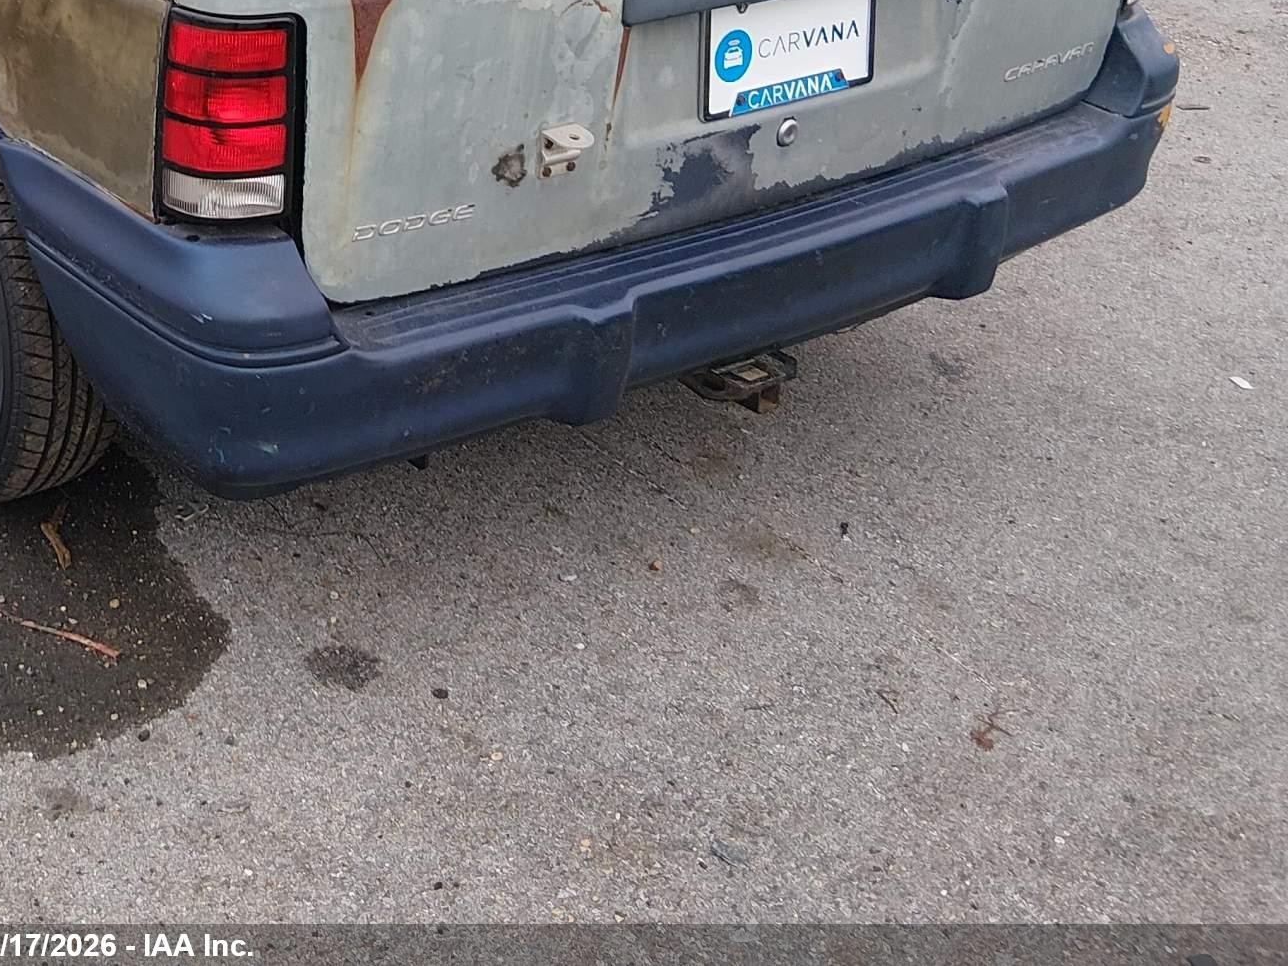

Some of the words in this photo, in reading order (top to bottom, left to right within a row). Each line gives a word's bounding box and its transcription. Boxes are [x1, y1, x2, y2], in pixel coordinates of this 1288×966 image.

[758, 19, 860, 59] CARVANA
[748, 74, 833, 109] CARVANA
[351, 203, 476, 242] DODGE
